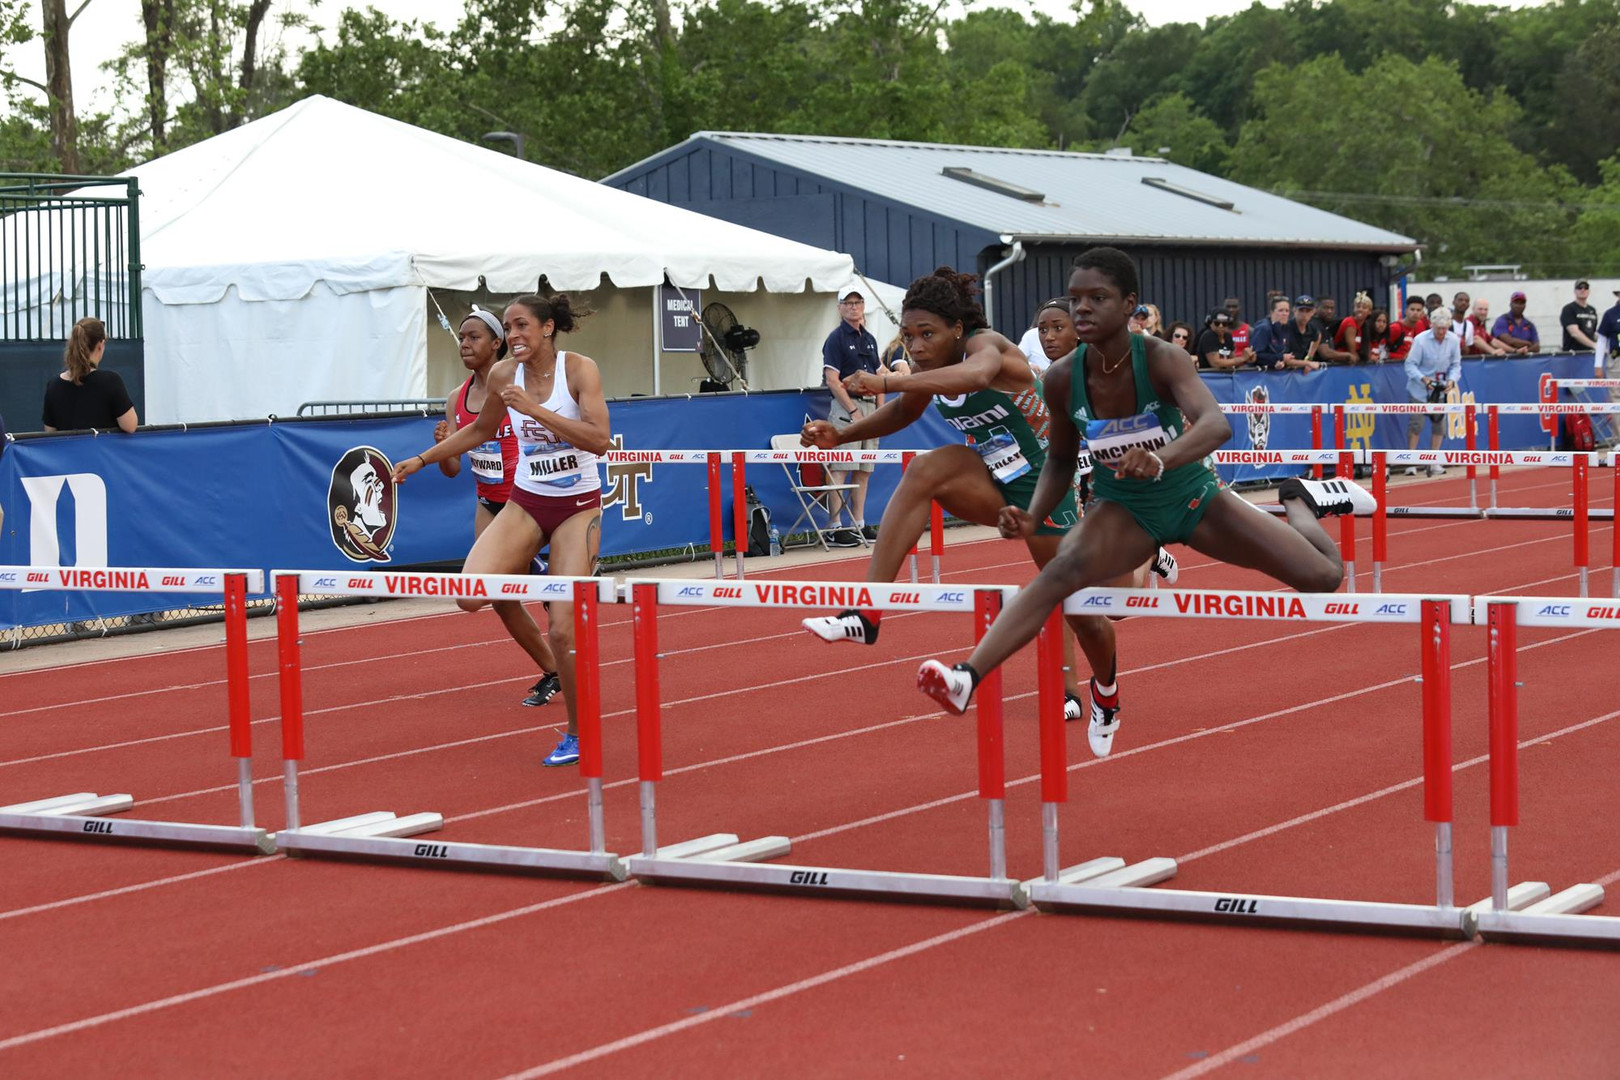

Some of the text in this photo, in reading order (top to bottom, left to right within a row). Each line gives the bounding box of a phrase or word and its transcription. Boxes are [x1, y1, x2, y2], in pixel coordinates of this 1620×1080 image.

[673, 315, 689, 327] TENT
[1100, 415, 1149, 435] ACC
[607, 452, 662, 462] VIRGINIA
[795, 452, 854, 462] VIRGINIA
[1216, 452, 1283, 463] VIRGINIA
[1444, 452, 1514, 464] VIRGINIA
[1523, 455, 1542, 463] GILL
[530, 454, 578, 476] MILLER
[26, 572, 49, 583] GILL
[59, 570, 150, 589] VIRGINIA
[162, 576, 186, 586] GILL
[195, 576, 216, 585] ACC
[314, 575, 567, 597] ACC GILL VIRGINIA GILL ACC
[678, 584, 965, 607] ACC GILL VIRGINIA GILL ACC
[1083, 593, 1406, 618] ACC GILL VIRGINIA GILL ACC
[1538, 605, 1571, 616] ACC
[83, 820, 113, 834] GILL
[414, 844, 448, 858] GILL
[789, 871, 829, 886] GILL
[1214, 898, 1258, 914] GILL
